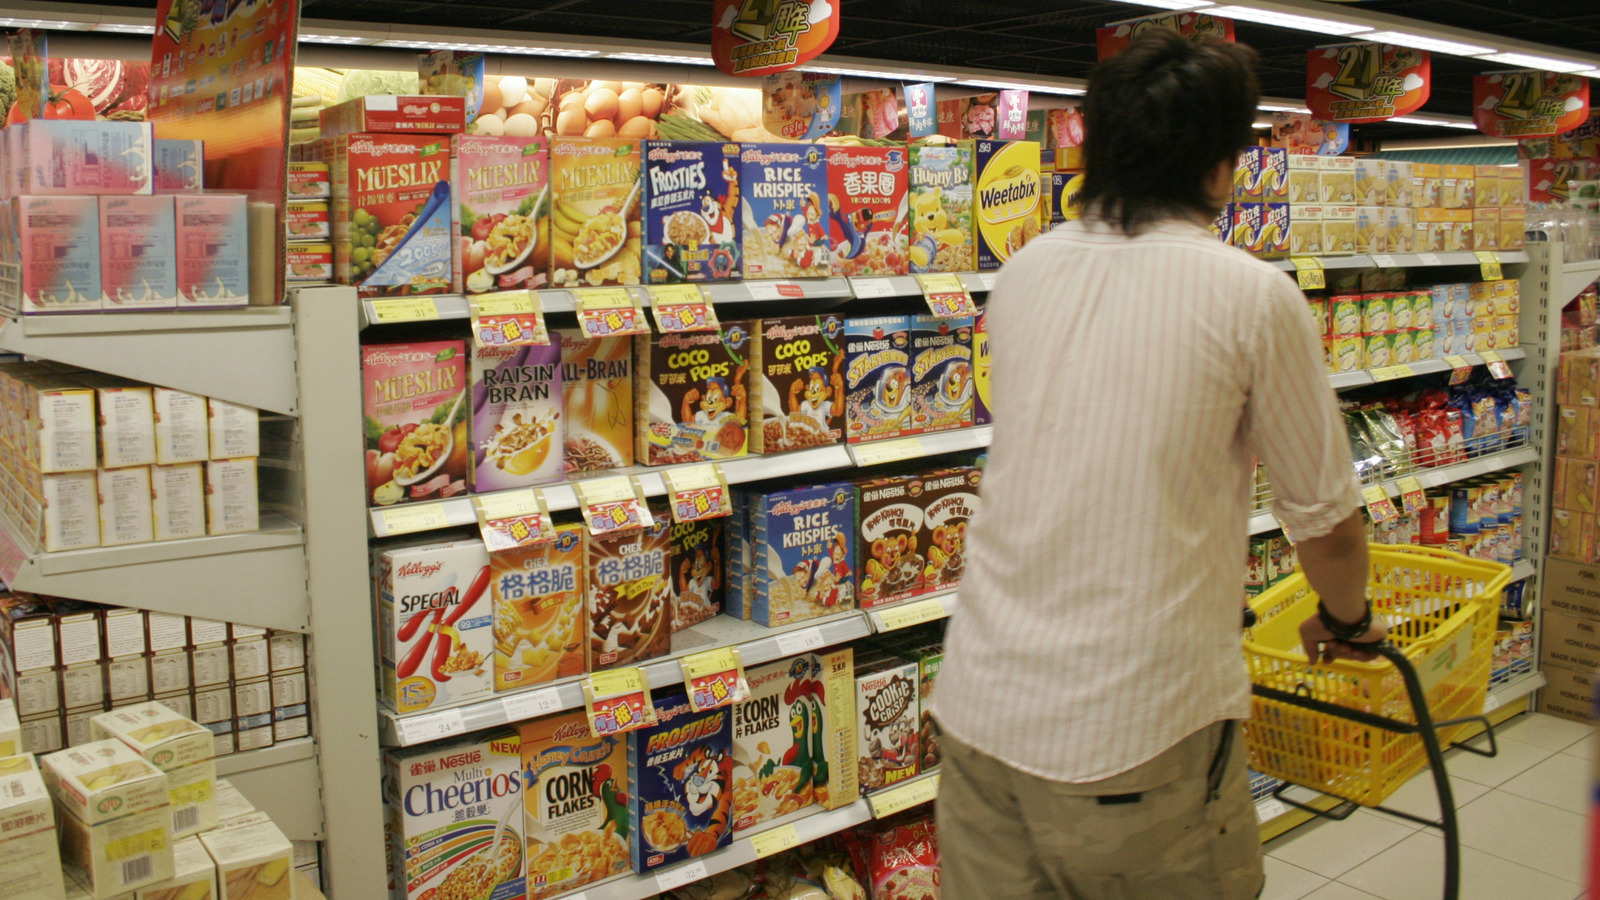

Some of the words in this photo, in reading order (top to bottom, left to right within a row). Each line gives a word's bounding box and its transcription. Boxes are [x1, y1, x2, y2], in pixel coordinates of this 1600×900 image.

[1328, 43, 1382, 100] 21
[979, 143, 991, 152] 24
[808, 153, 817, 161] 10
[357, 160, 442, 192] MÜESLIX
[468, 160, 542, 191] MÜESLIX
[649, 161, 706, 196] FROSTIES
[764, 167, 802, 182] RICE
[843, 171, 896, 196] 香果圈
[912, 166, 951, 188] Hunny
[954, 168, 969, 186] B's
[1053, 175, 1062, 185] 12
[753, 183, 812, 198] KRISPIES
[980, 175, 1036, 209] Weetabix
[828, 323, 836, 332] 10
[731, 333, 740, 342] 10
[775, 339, 811, 360] COCO
[668, 350, 710, 369] COCO
[794, 352, 828, 372] POPS
[483, 365, 555, 386] RAISIN
[690, 362, 729, 382] POPS
[374, 365, 457, 404] MÜESLIX
[489, 384, 549, 404] BRAN
[925, 480, 940, 491] 雀巢
[836, 496, 845, 505] 10
[863, 490, 879, 502] 雀巢
[941, 496, 965, 509] KRUNCH
[793, 511, 830, 531] RICE
[880, 508, 904, 520] KRUNCH
[561, 535, 572, 545] 10
[683, 528, 709, 550] POPS
[783, 525, 839, 548] KRISPIES
[619, 542, 643, 555] CHEX
[398, 561, 442, 577] Kellogg's
[523, 556, 550, 570] CHEX
[598, 551, 663, 585] 格格脆
[500, 566, 575, 599] 格格脆
[1565, 586, 1585, 595] HONG
[400, 589, 461, 613] SPECIAL
[1551, 600, 1570, 609] MADE
[1564, 638, 1584, 648] HONG
[718, 659, 728, 668] 11
[1550, 651, 1568, 661] MADE
[626, 679, 636, 688] 12
[861, 676, 887, 692] Nestlé
[1560, 691, 1579, 700] HONG
[538, 701, 549, 710] 12
[743, 694, 779, 723] CORN
[1546, 703, 1565, 714] MADE
[1566, 708, 1573, 716] IN
[438, 724, 450, 733] 24
[735, 703, 743, 739] 玉米片
[744, 716, 780, 736] FLAKES
[553, 724, 591, 742] Kellogg
[646, 712, 724, 753] FROSTIES
[490, 742, 520, 754] NEW
[440, 750, 482, 771] Nestlé
[530, 751, 570, 775] Honey
[570, 742, 611, 763] Crunch
[409, 760, 436, 776] 雀巢
[453, 766, 483, 783] Multi
[885, 765, 916, 784] NEW
[404, 770, 521, 817] Cheerios
[546, 767, 594, 804] CORN
[548, 794, 595, 820] FLAKES
